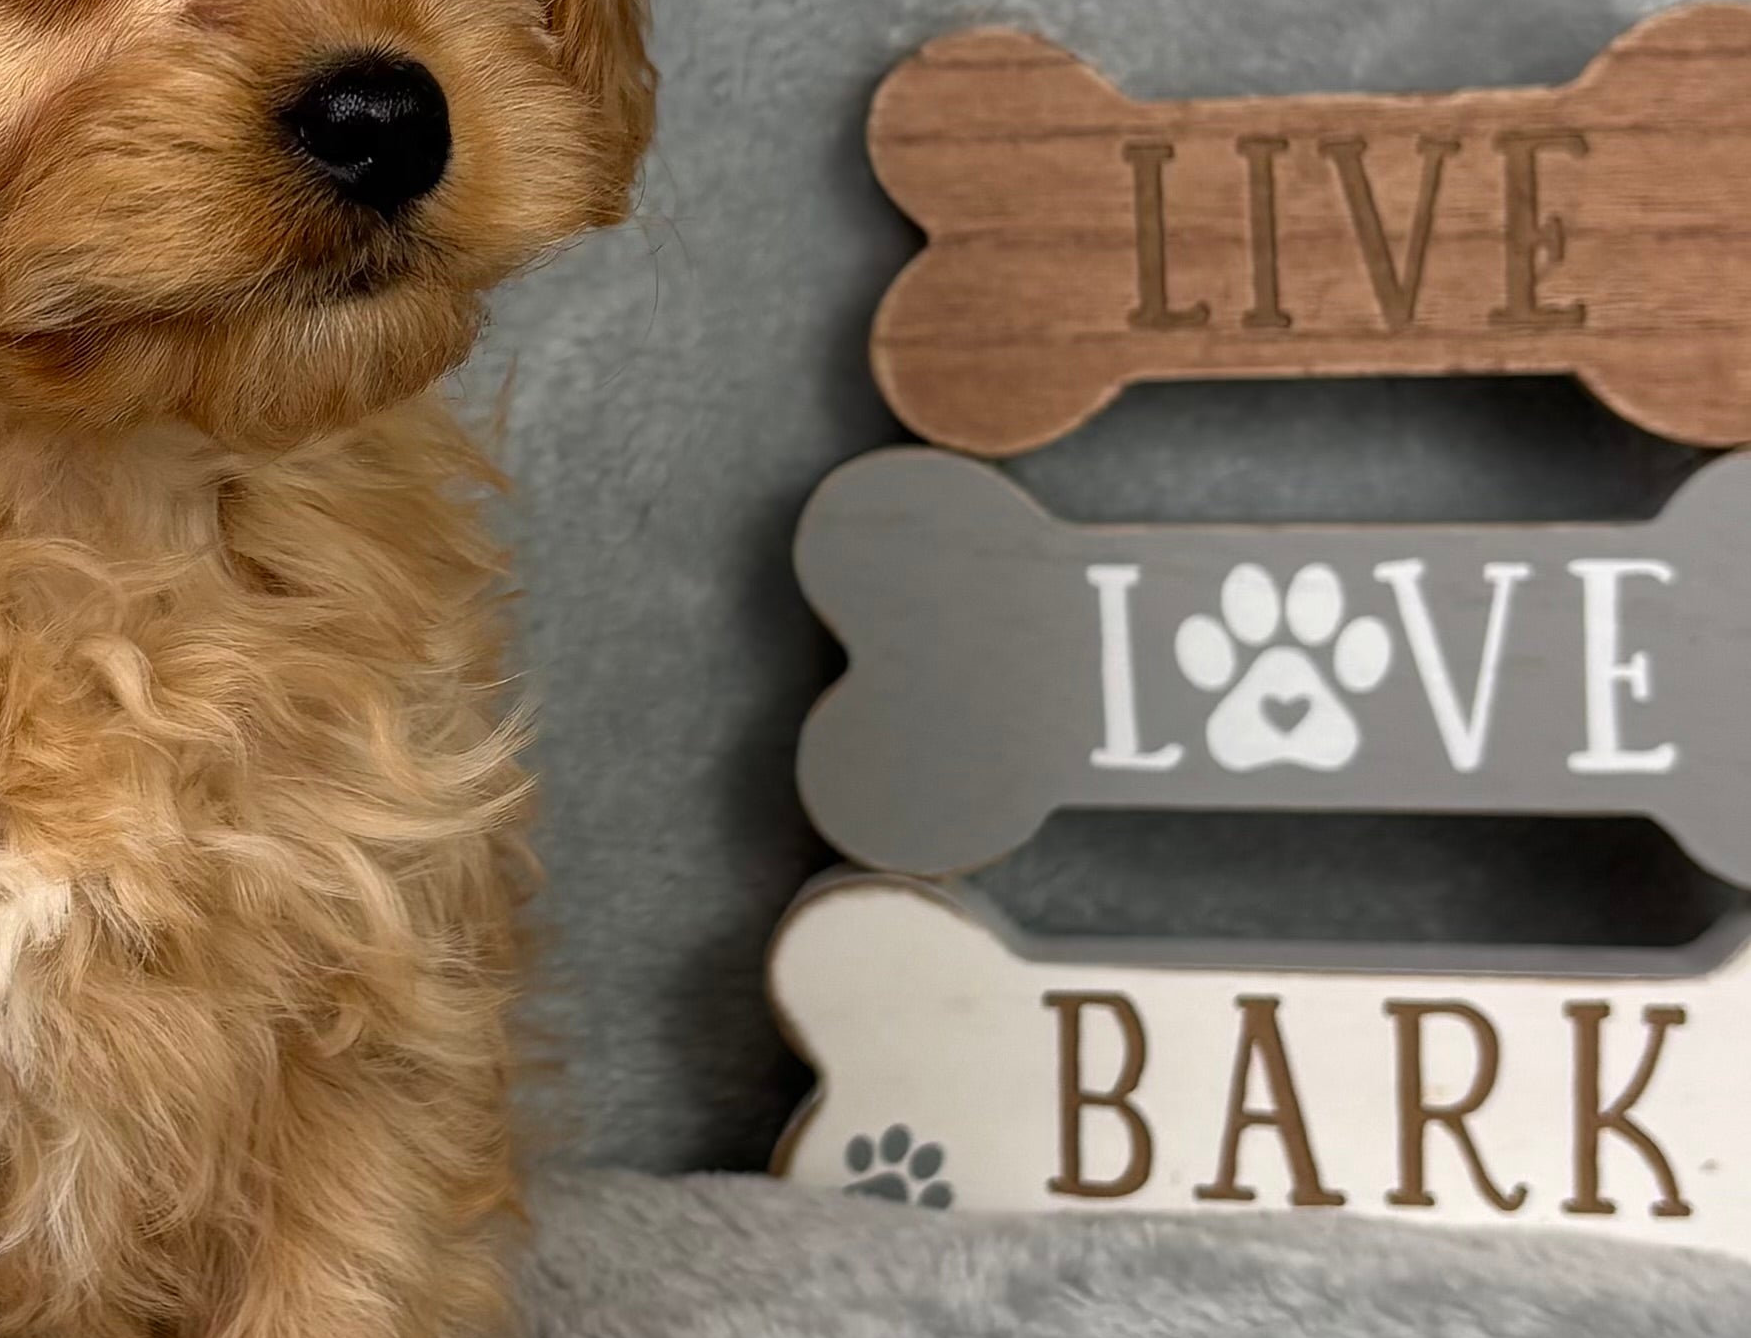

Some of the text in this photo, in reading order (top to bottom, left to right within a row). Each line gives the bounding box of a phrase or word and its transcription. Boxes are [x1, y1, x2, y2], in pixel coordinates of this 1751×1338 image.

[1122, 131, 1590, 329] LIVE
[1086, 558, 1677, 773] LVE
[1043, 990, 1693, 1217] BARK
